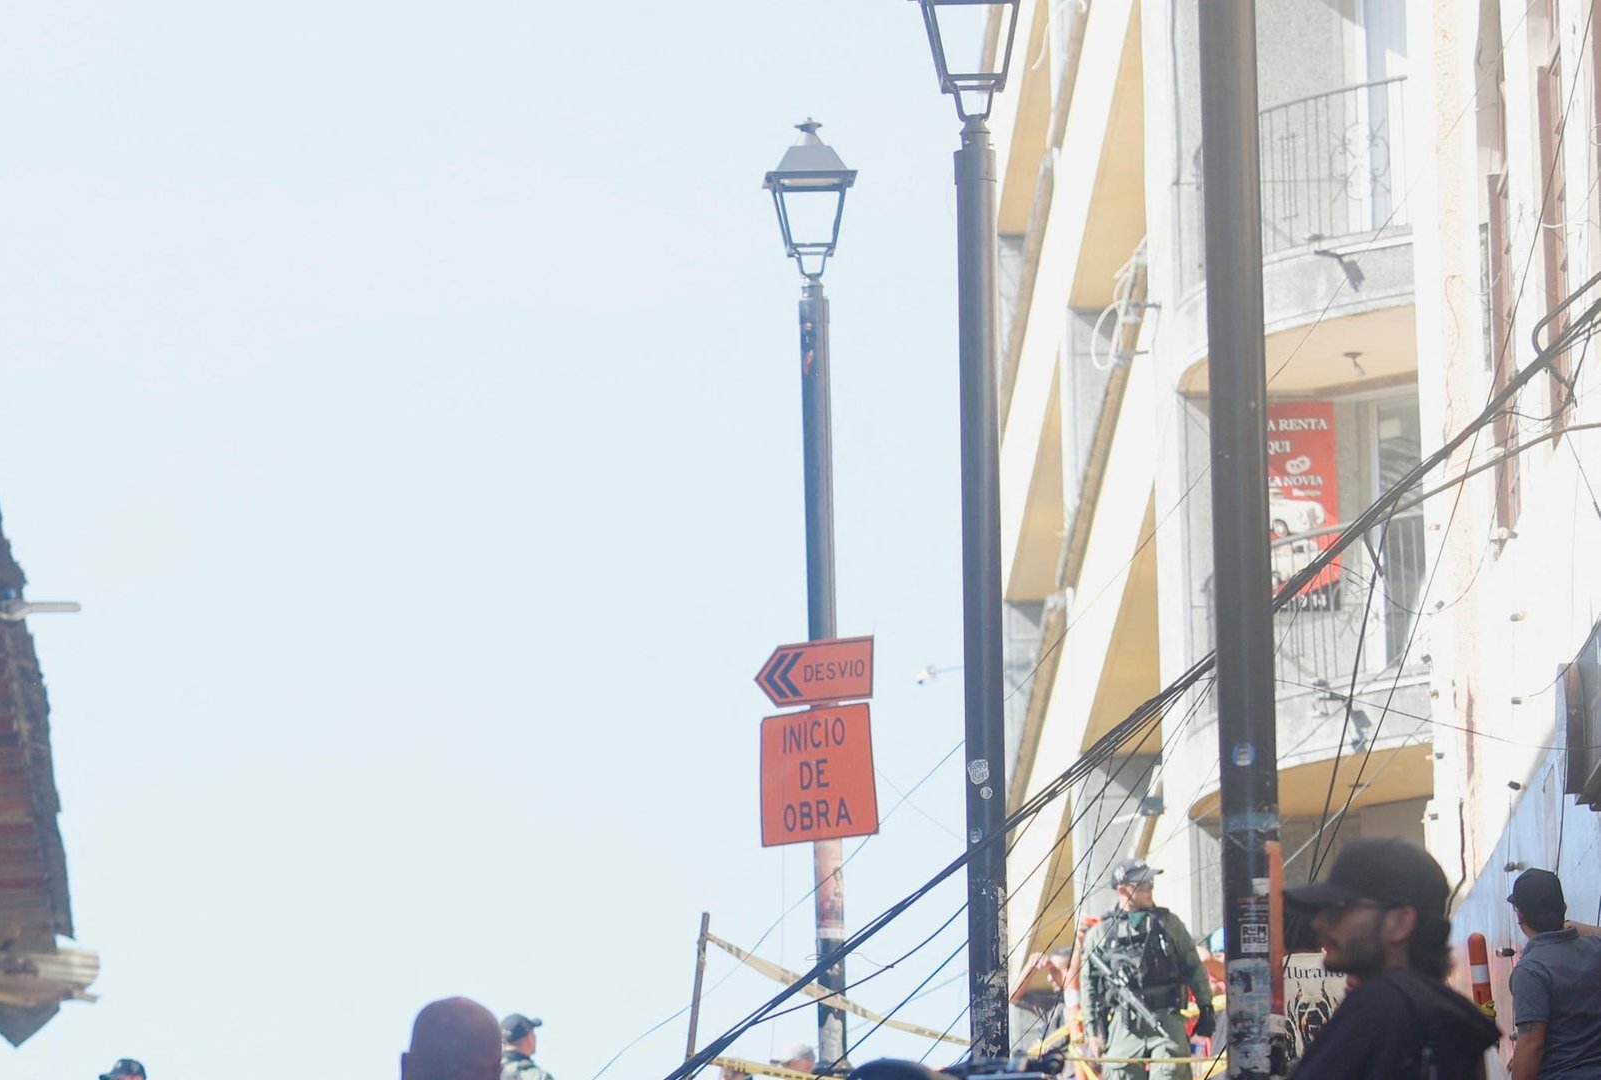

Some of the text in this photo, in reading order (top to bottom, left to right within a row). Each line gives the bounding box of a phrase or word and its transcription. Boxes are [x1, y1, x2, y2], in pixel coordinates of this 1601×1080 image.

[1279, 417, 1328, 431] RENTA
[1283, 475, 1323, 487] NOVIA
[803, 658, 866, 683] DESVIO
[783, 716, 846, 755] INICIO
[799, 758, 830, 791] DE
[783, 797, 853, 833] OBRA
